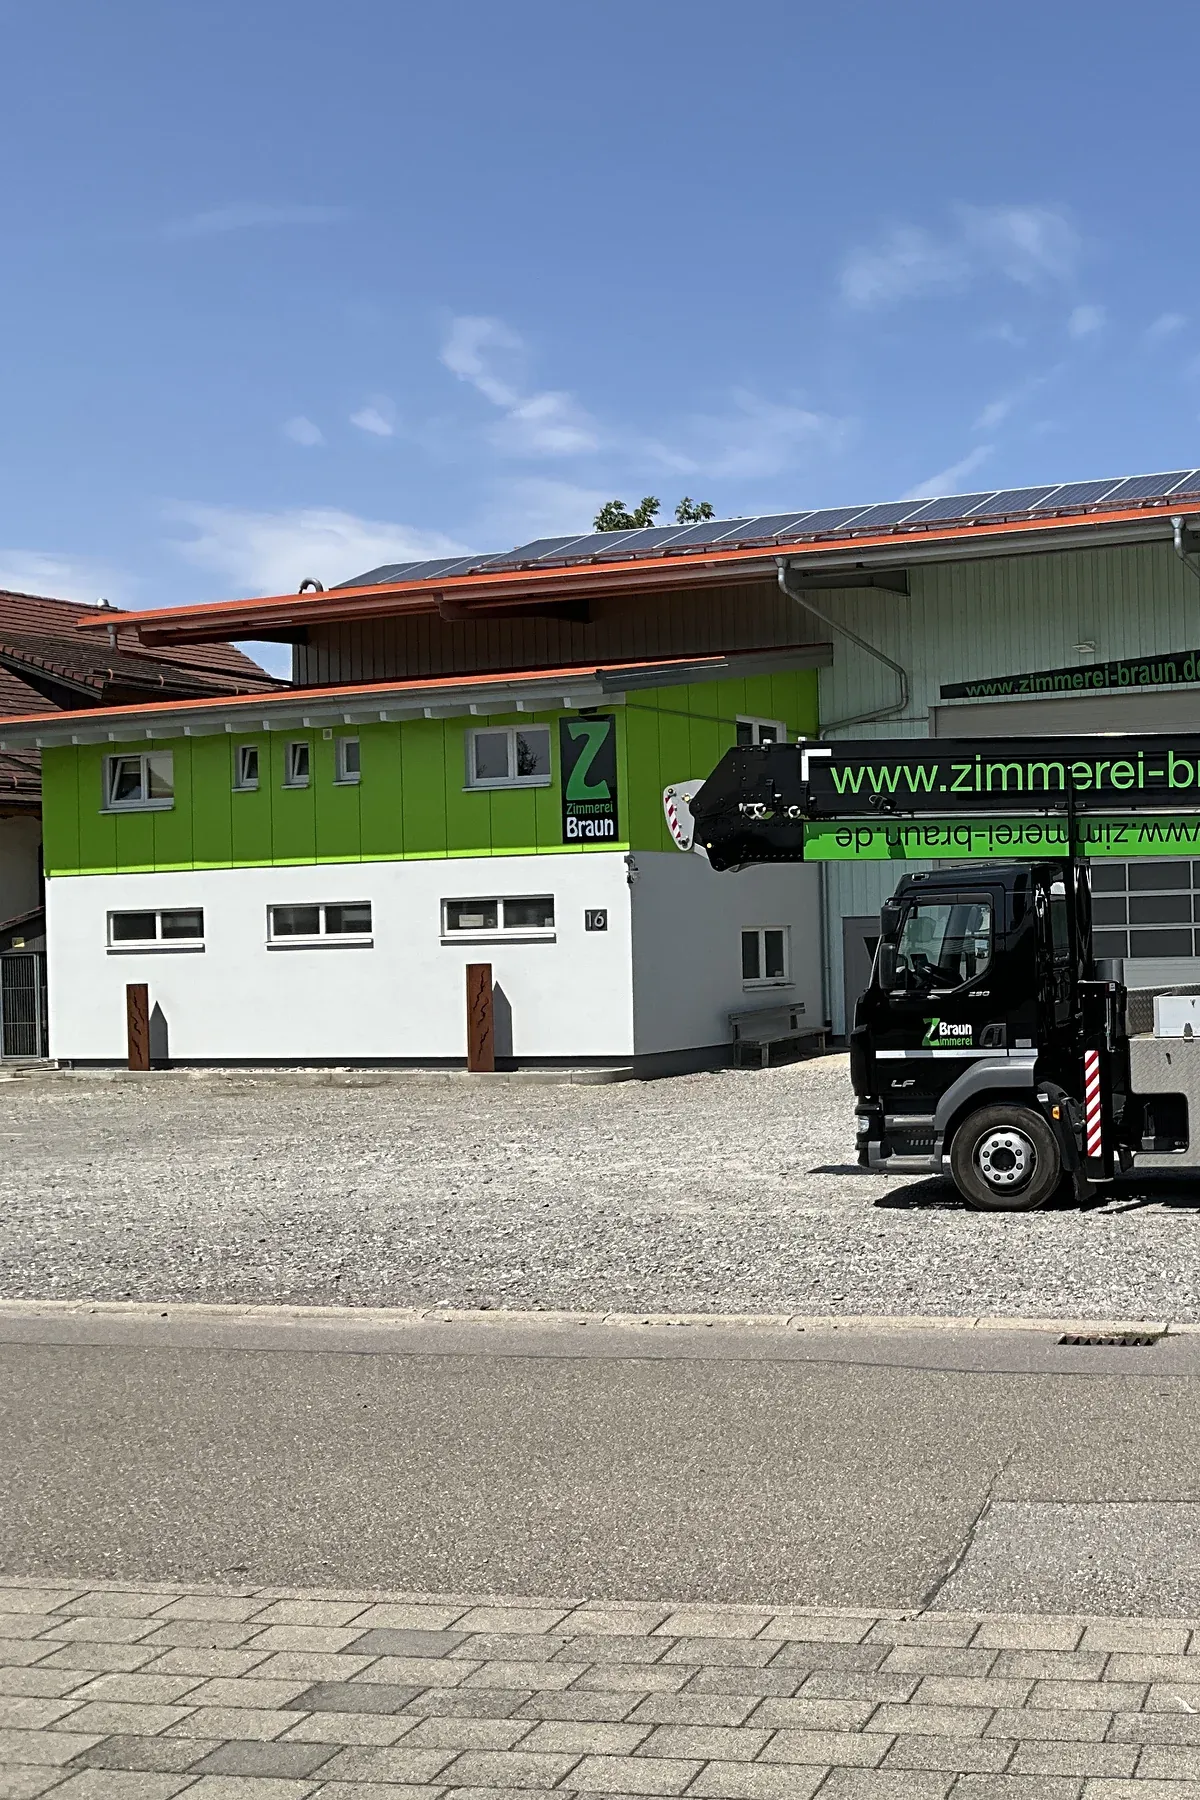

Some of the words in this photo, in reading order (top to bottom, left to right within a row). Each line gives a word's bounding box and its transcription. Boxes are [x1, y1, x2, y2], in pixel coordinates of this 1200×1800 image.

[566, 801, 614, 815] Zimmerei
[566, 816, 614, 838] Braun
[586, 910, 605, 928] 16
[939, 1022, 973, 1036] Braun
[891, 1079, 916, 1088] LF
